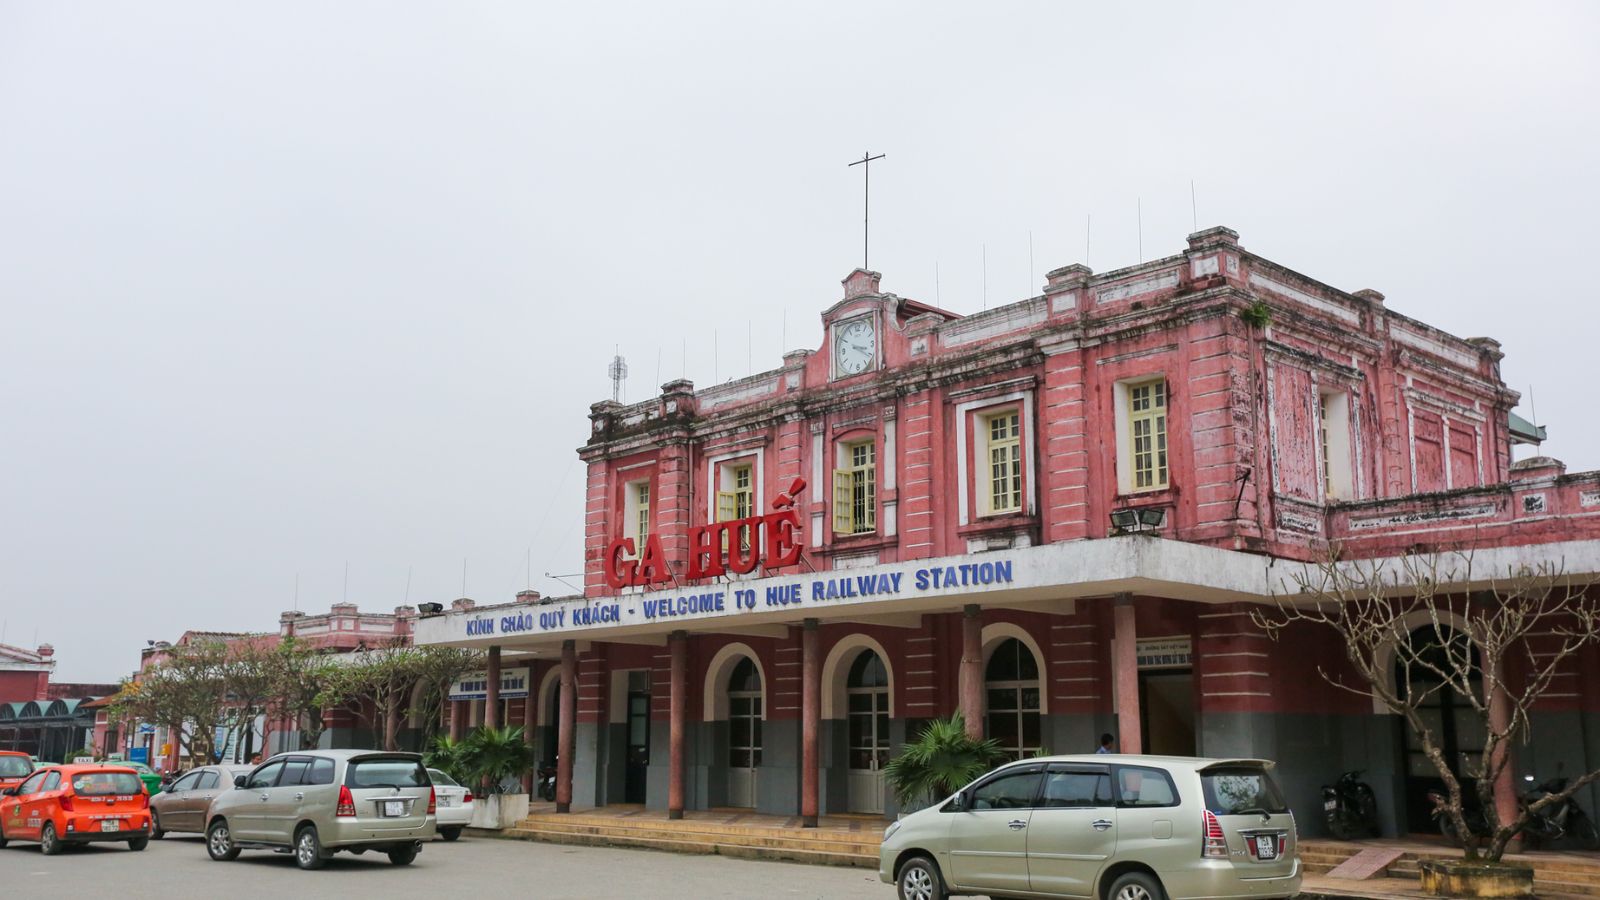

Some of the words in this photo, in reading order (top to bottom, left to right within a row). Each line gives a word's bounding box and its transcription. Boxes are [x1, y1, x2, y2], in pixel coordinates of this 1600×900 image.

[604, 533, 673, 589] GA
[686, 477, 807, 580] HUẾ
[466, 615, 495, 636] KÍNH
[500, 611, 533, 633] CHÀO
[539, 606, 565, 630] QUÝ
[572, 602, 621, 626] KHÁCH
[643, 592, 725, 619] WELCOME
[735, 588, 757, 609] TO
[766, 583, 803, 607] HUE
[812, 572, 903, 601] RAILWAY
[915, 560, 1014, 591] STATION
